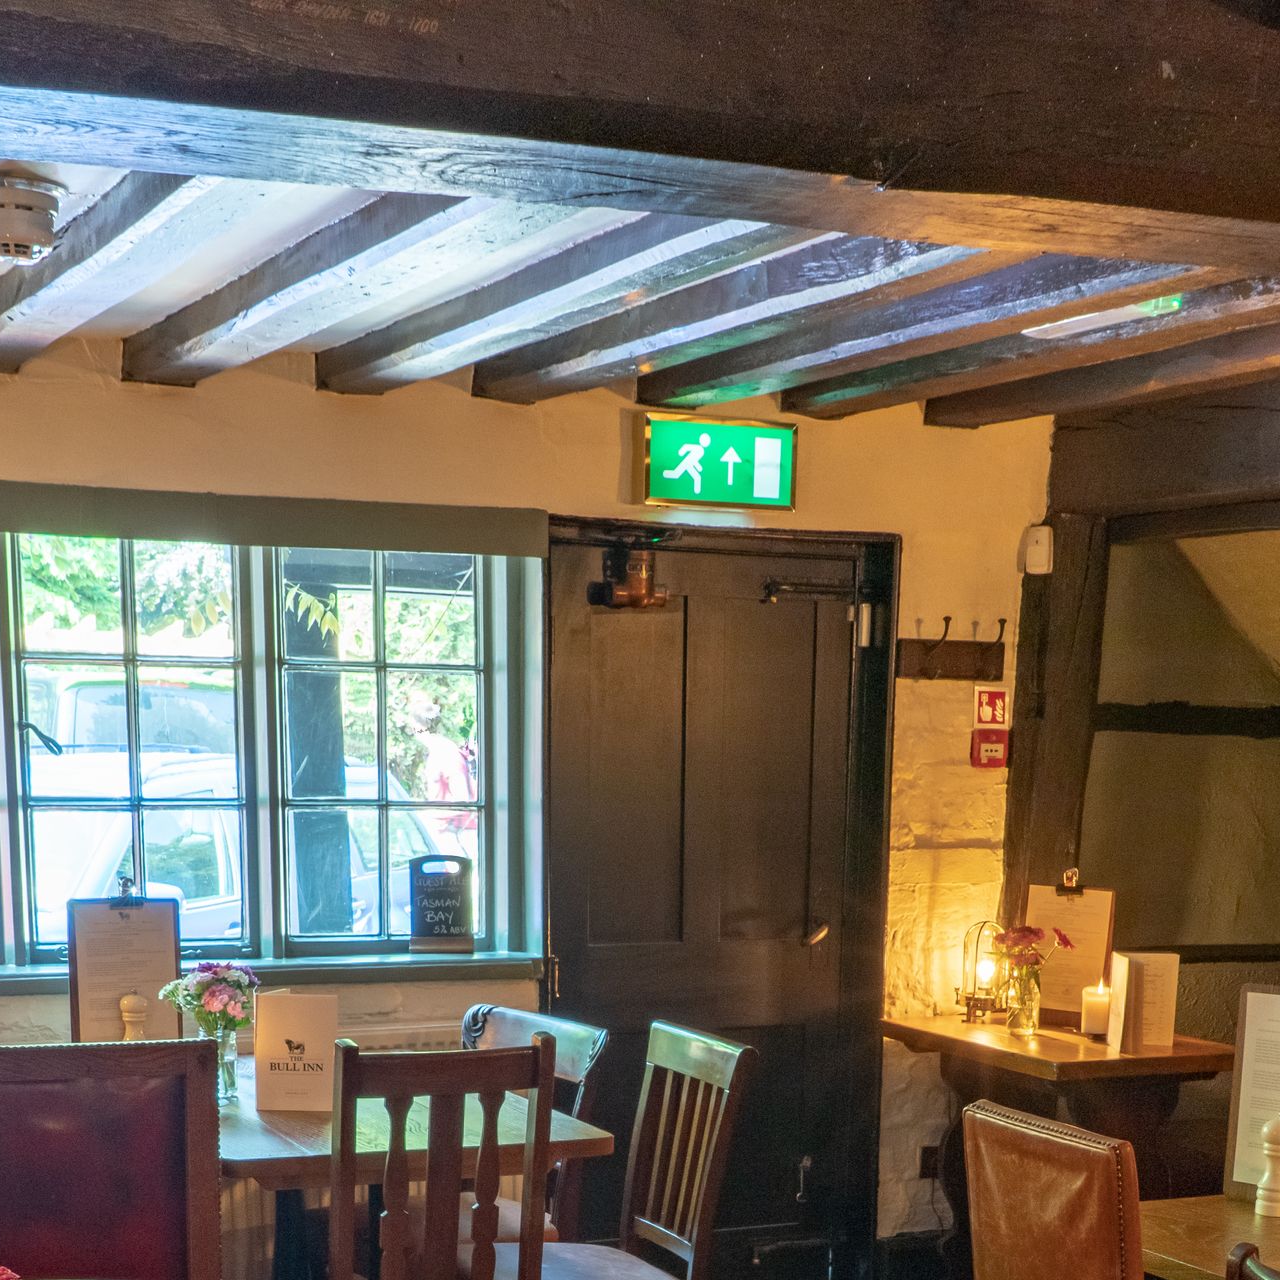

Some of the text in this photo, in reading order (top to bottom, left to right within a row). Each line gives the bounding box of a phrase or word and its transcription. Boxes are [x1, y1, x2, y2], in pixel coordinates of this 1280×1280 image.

[415, 873, 469, 887] GUEST ALE
[415, 895, 461, 908] TASMAN
[424, 910, 454, 925] BAY
[450, 926, 467, 935] ABV
[269, 1062, 324, 1072] BULL INN
